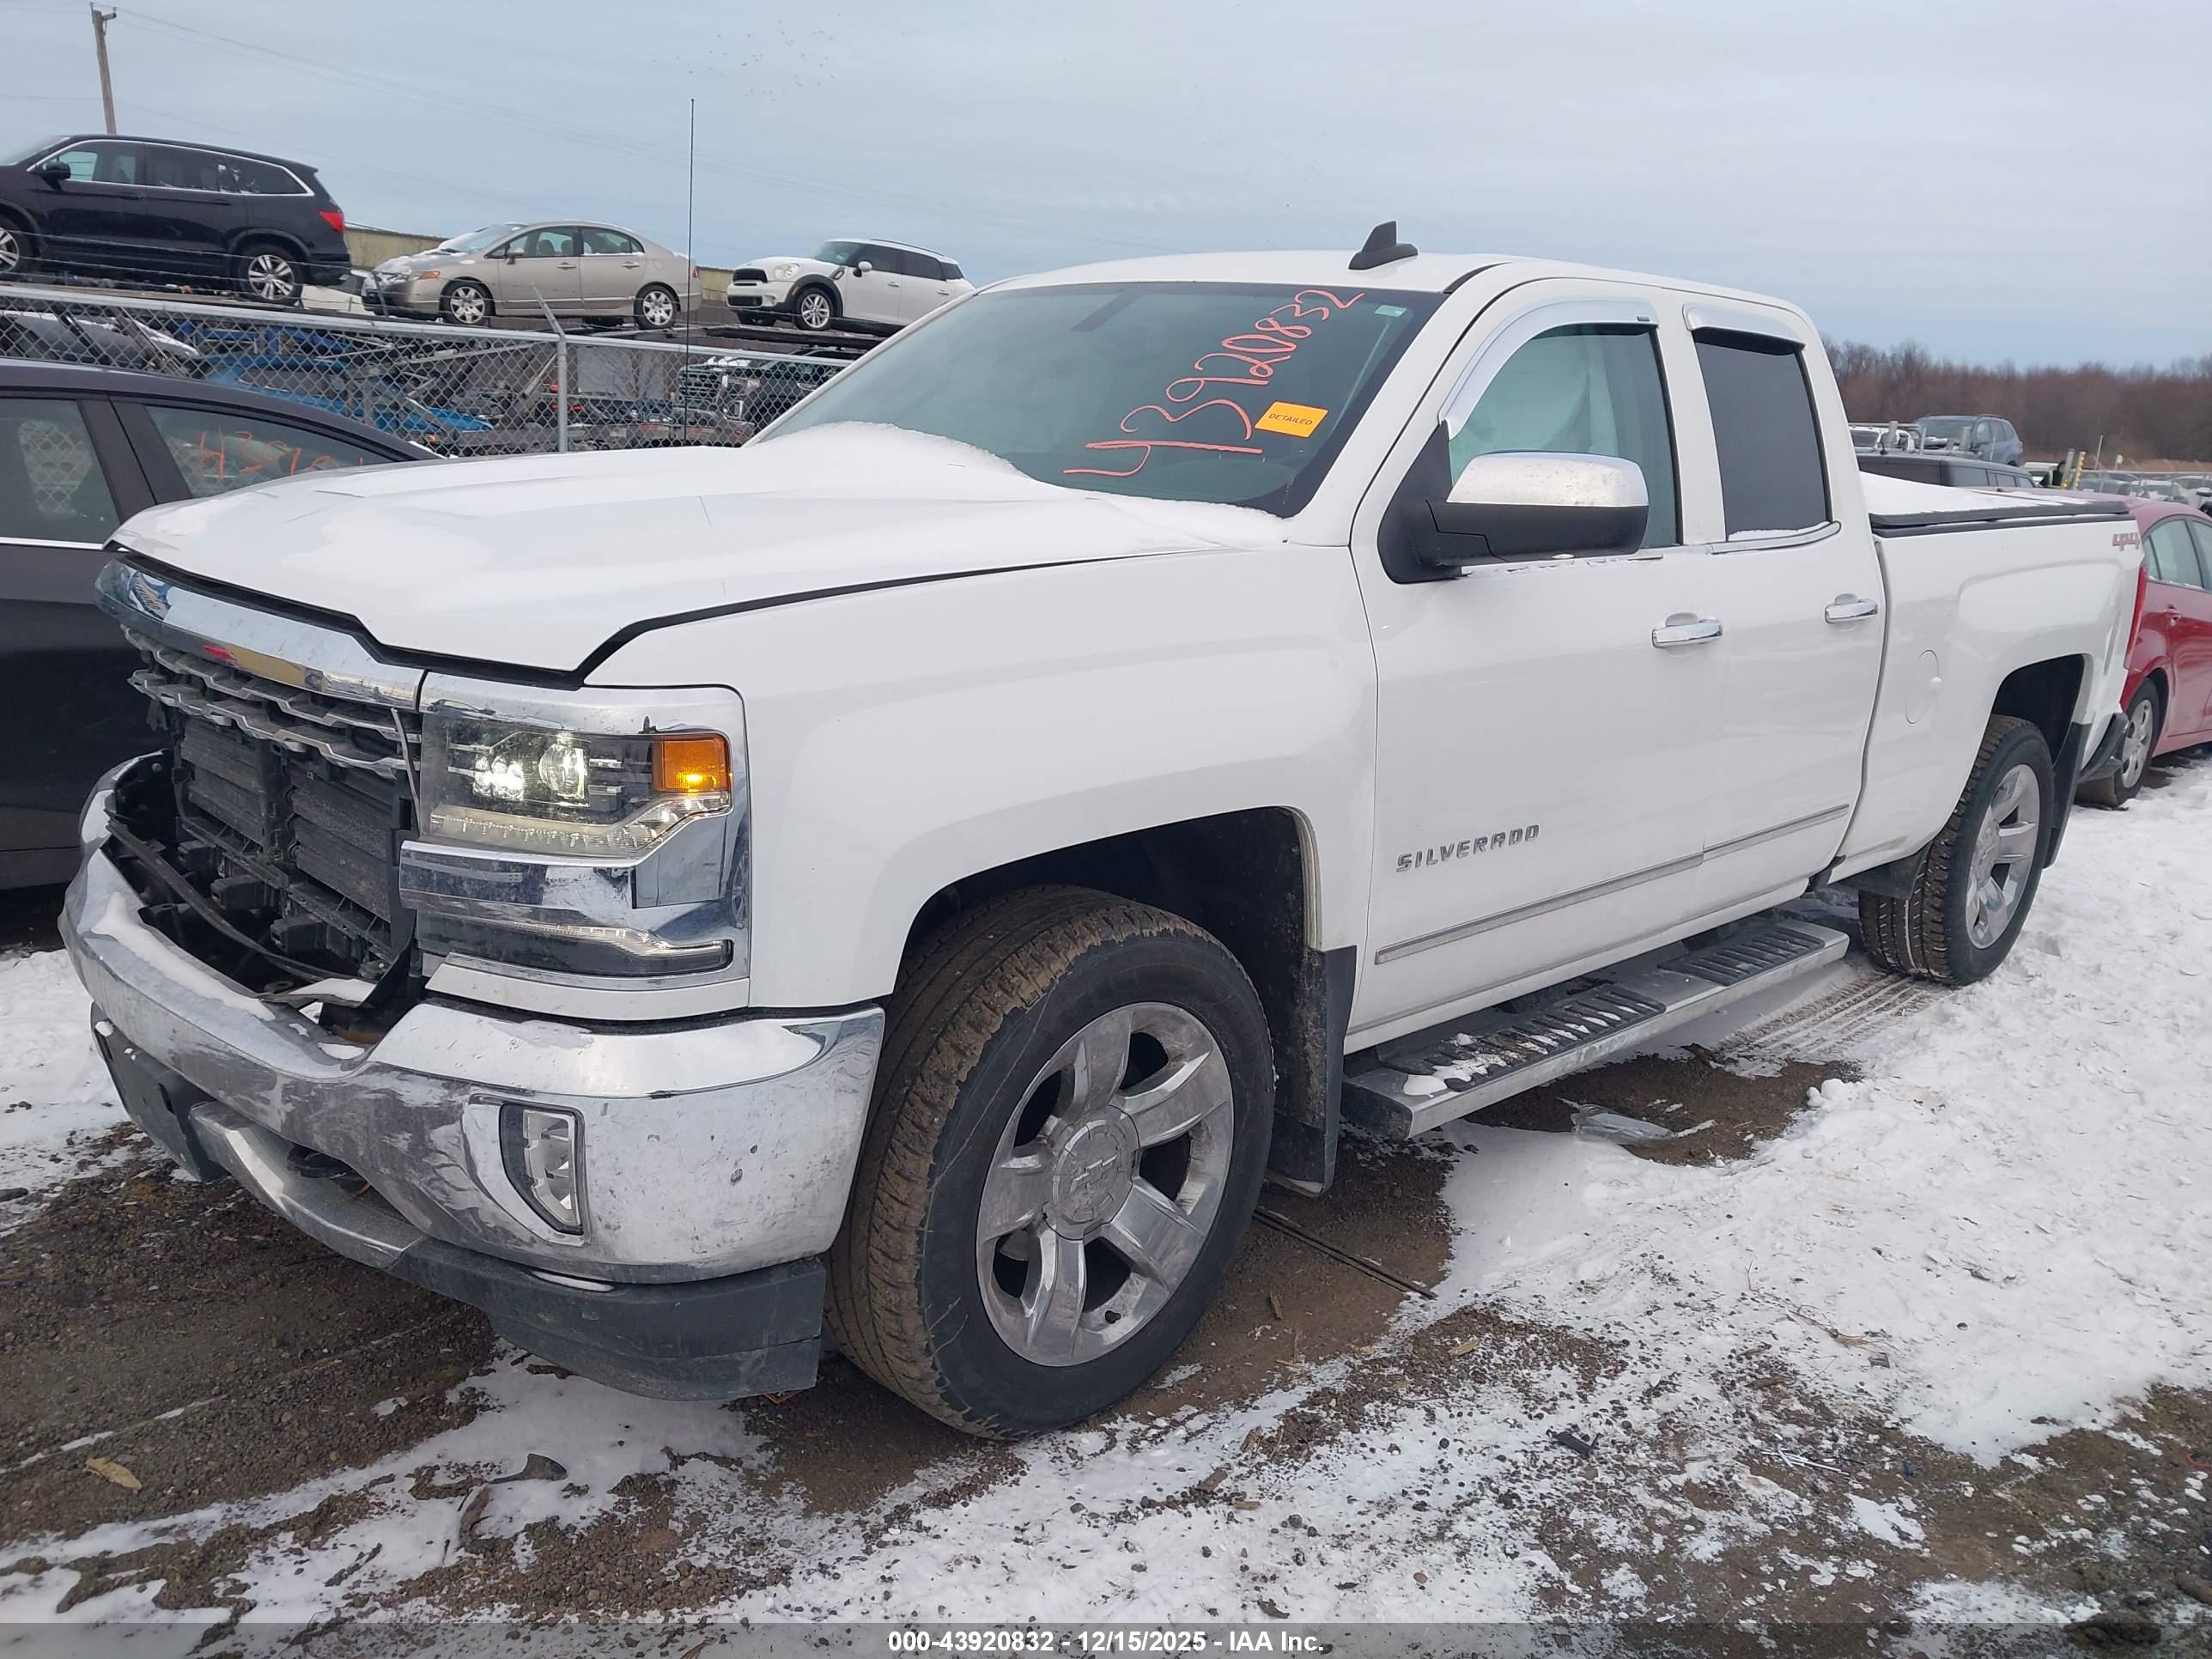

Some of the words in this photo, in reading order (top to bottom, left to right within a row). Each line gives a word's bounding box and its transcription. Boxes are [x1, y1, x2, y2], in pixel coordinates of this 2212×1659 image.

[1062, 289, 1365, 477] 43920832
[1268, 413, 1313, 426] DETAILED
[1396, 824, 1540, 872] SILVERADO
